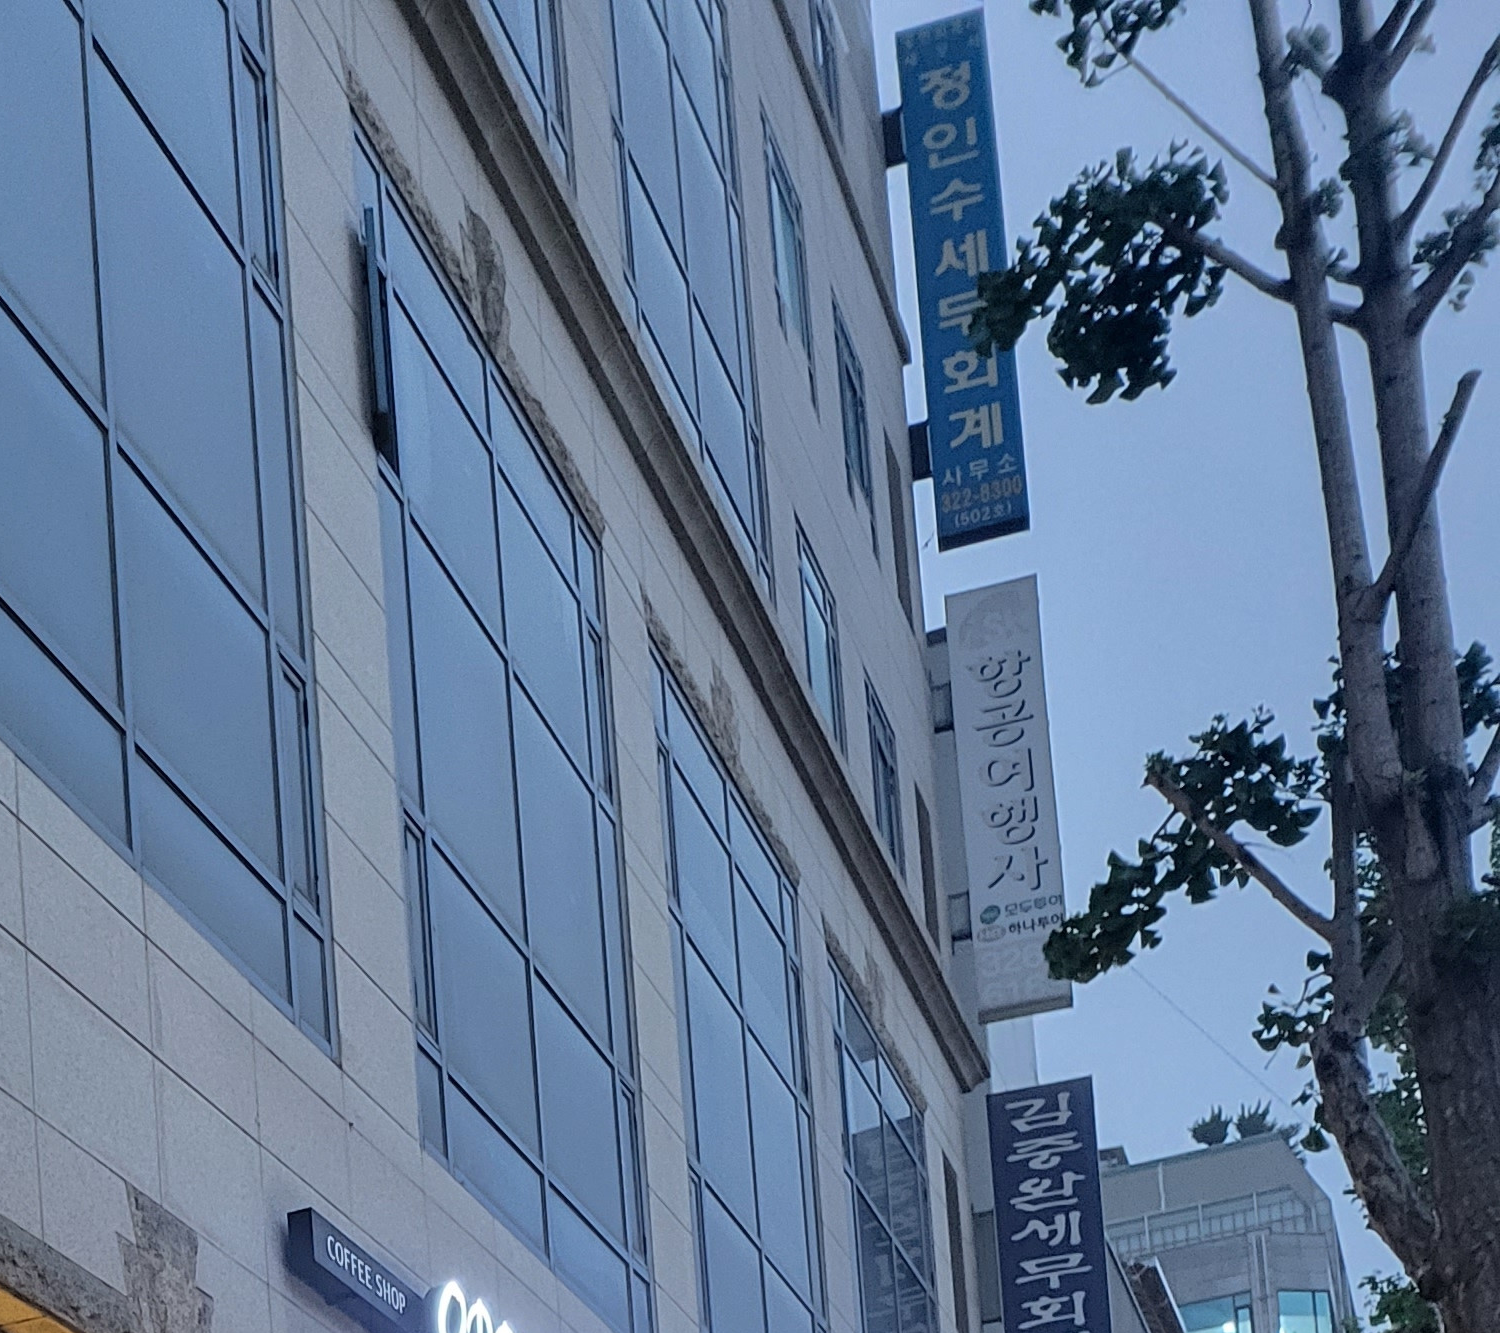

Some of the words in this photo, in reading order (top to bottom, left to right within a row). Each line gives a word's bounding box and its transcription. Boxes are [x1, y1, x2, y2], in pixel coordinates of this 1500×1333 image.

[941, 453, 1018, 487] 사무소
[327, 1235, 373, 1290] COFFEE
[375, 1273, 407, 1314] SHOP
